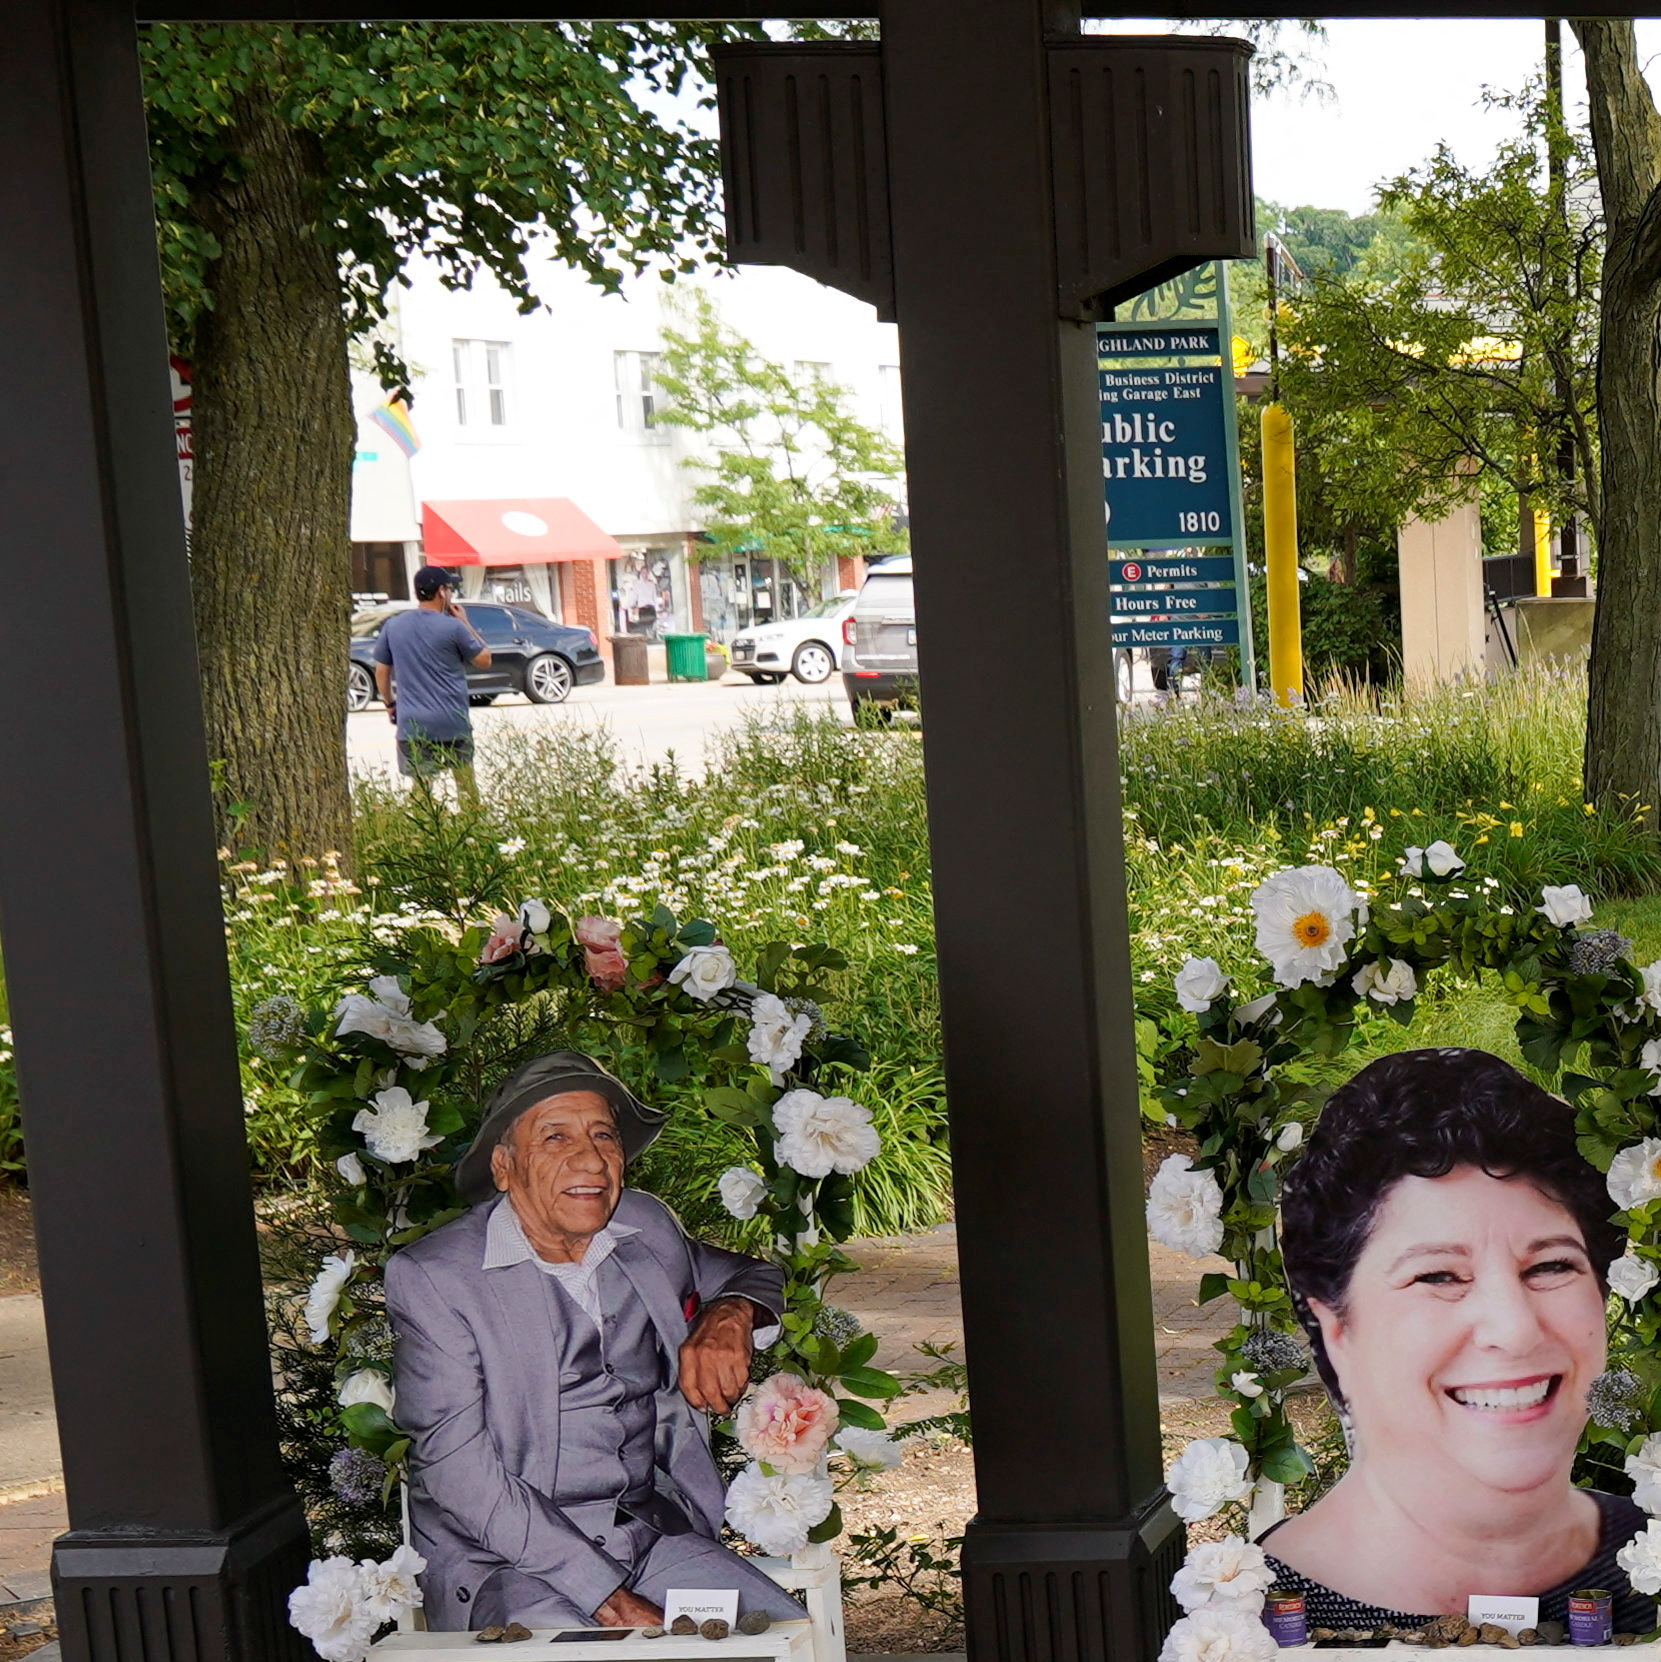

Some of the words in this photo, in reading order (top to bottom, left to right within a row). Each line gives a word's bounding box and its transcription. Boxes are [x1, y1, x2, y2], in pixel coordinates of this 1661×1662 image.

[1097, 338, 1166, 353] GHLAND
[1170, 335, 1210, 350] PARK
[1105, 373, 1160, 387] Business
[1165, 370, 1215, 385] District
[1122, 387, 1169, 402] Garage
[1172, 386, 1201, 399] East
[1178, 510, 1221, 533] 1810
[1127, 566, 1136, 577] E
[1146, 564, 1198, 578] Permits
[491, 581, 533, 605] Nails
[1115, 596, 1160, 611] Hours
[1164, 595, 1197, 609] Free
[1131, 629, 1170, 642] Meter
[1173, 626, 1224, 642] Parking
[1496, 1613, 1526, 1621] MATTER
